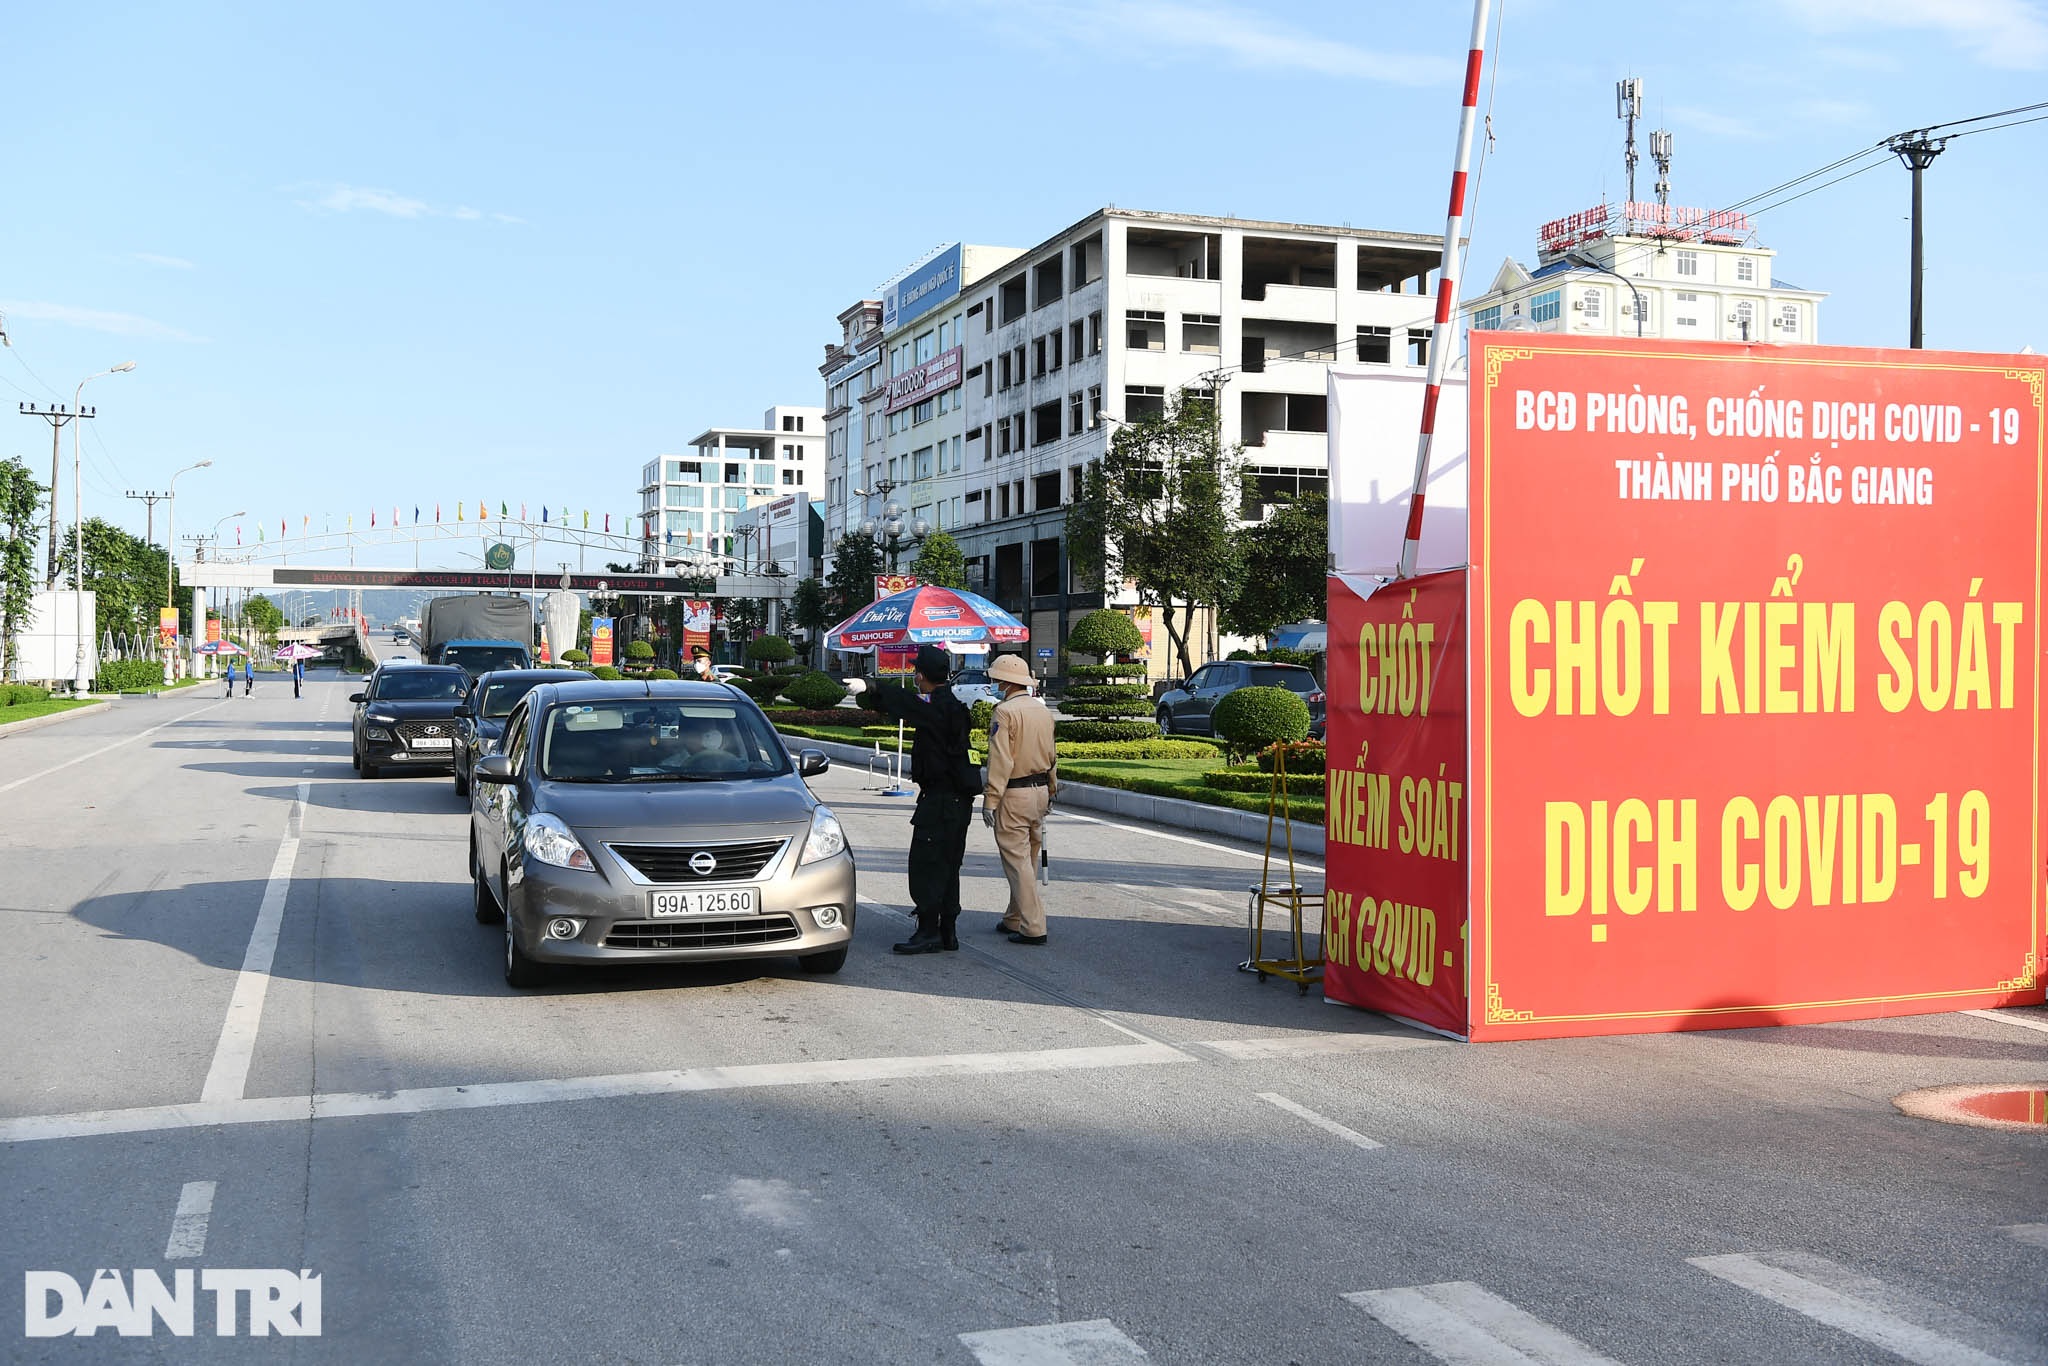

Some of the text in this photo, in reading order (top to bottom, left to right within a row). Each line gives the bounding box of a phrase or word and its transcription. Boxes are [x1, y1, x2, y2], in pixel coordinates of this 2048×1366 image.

[892, 369, 926, 400] MATDOOR
[1515, 389, 1577, 432] BCĐ
[1586, 384, 1697, 440] PHÒNG,
[1706, 385, 1804, 440] CHỐNG
[1812, 401, 1876, 449] DỊCH
[1883, 404, 1963, 444] COVID
[1988, 407, 2020, 445] 19
[1615, 450, 1934, 506] THÀNH PHỐ BẮC GIANG
[851, 632, 894, 642] SUNHOUSE
[921, 628, 972, 638] SUNHOUSE
[1359, 588, 1434, 717] CHỐT
[1509, 553, 2024, 717] CHỐT KIỂM SOÁT
[1329, 740, 1463, 862] KIỂM SOÁT
[1545, 789, 1991, 942] DỊCH COVID-19
[657, 892, 750, 914] 99A-125.60
[1356, 896, 1436, 987] COVID
